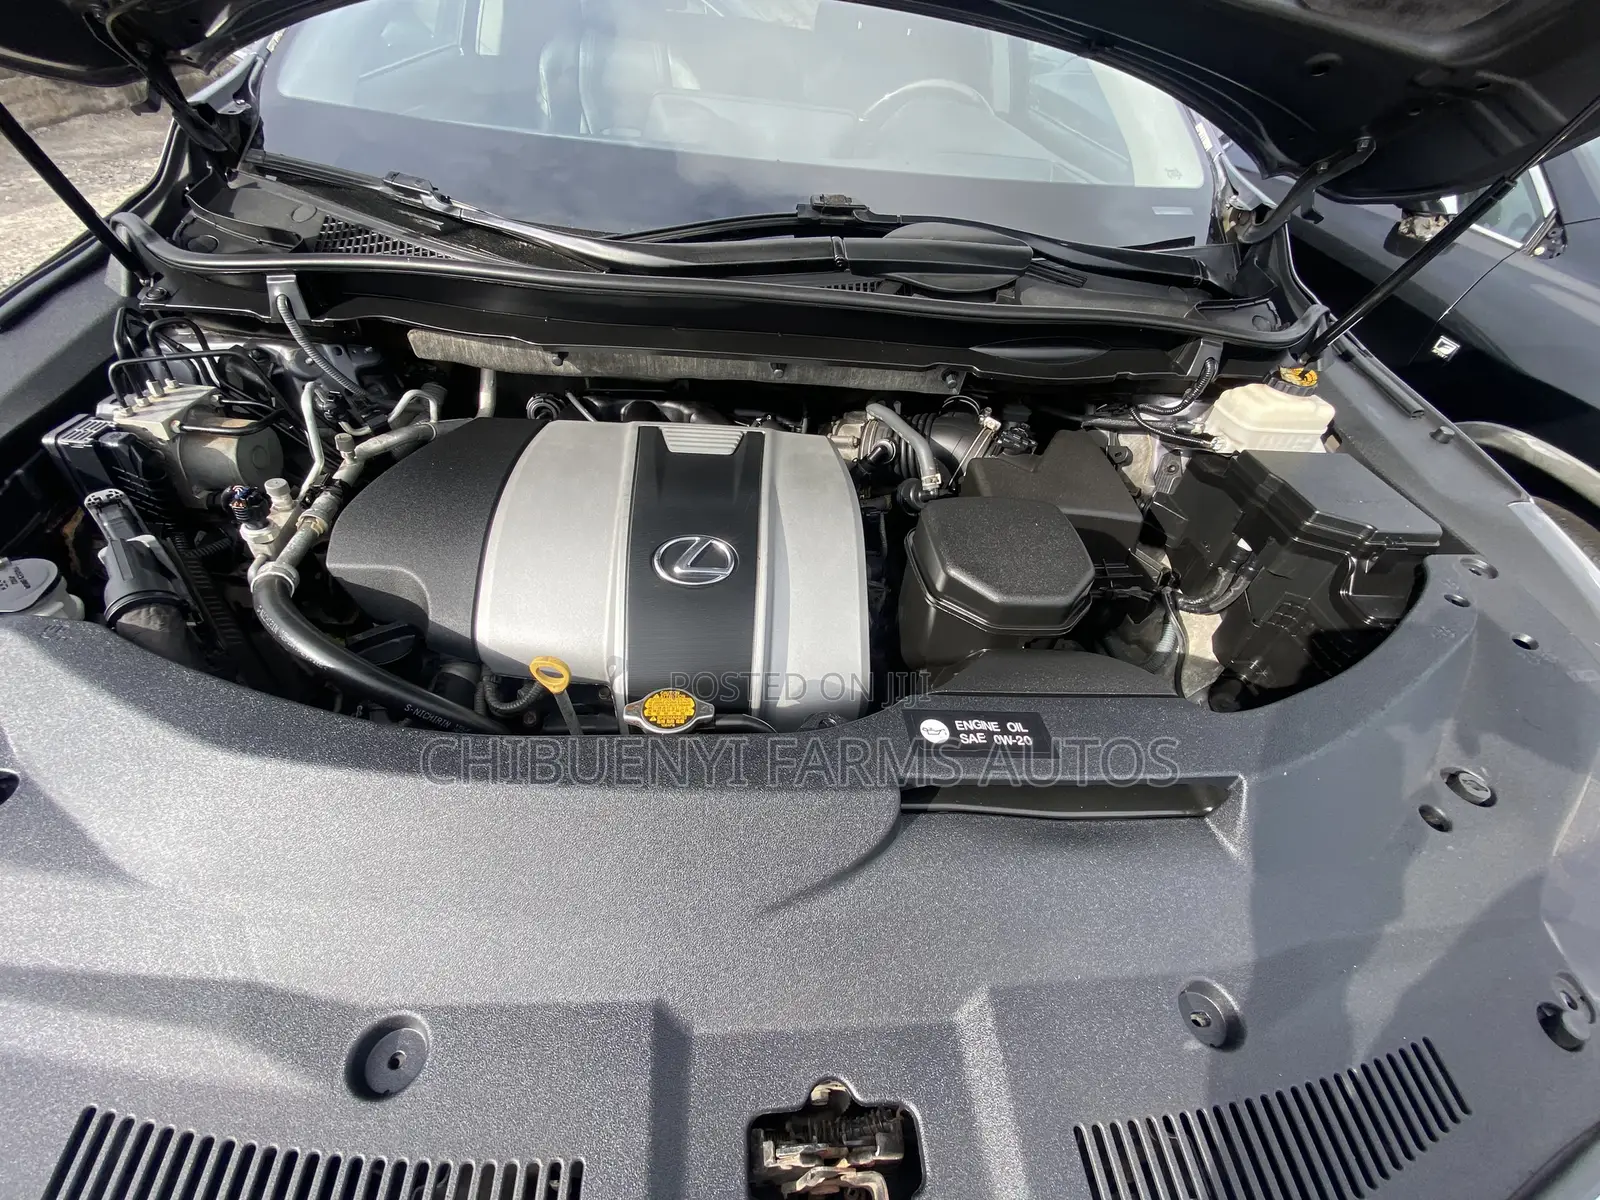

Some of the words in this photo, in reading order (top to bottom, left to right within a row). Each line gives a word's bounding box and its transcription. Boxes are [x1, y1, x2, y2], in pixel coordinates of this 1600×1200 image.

[955, 719, 1001, 732] ENGINE
[1006, 721, 1029, 733] OIL
[959, 732, 987, 745] SAE
[993, 734, 1033, 746] 0W-20
